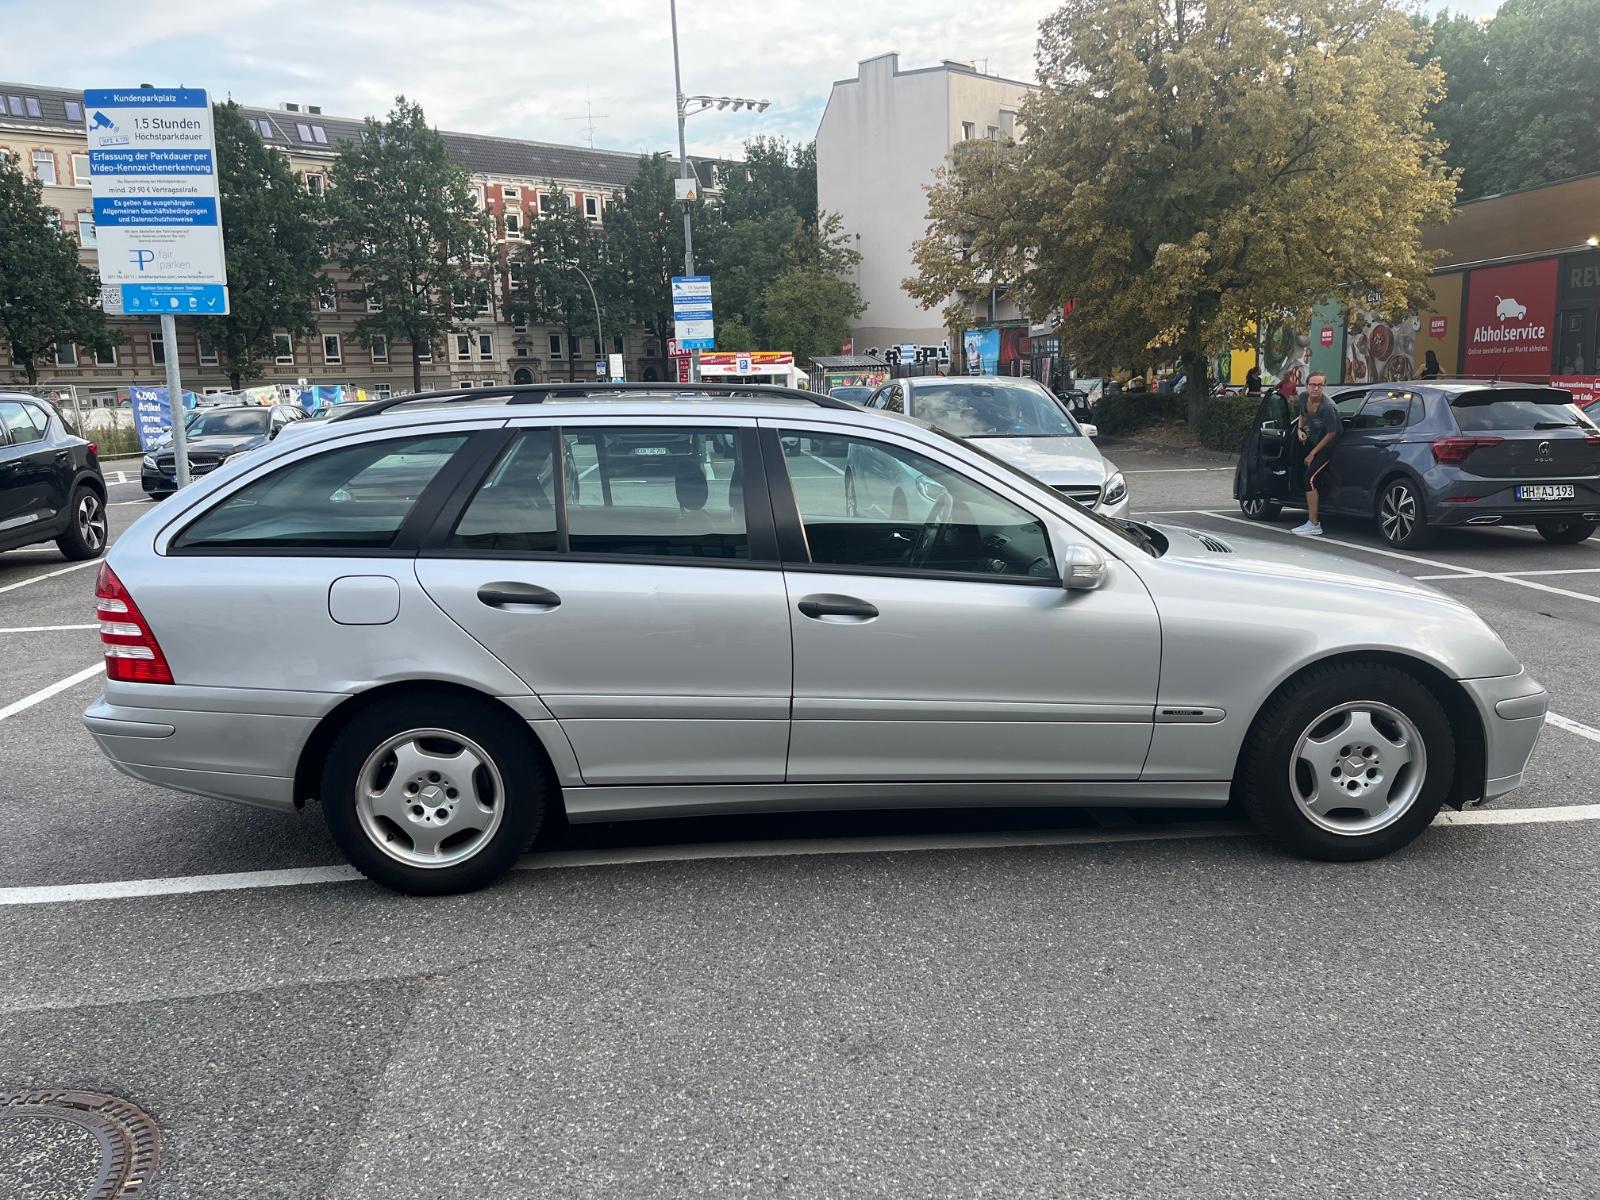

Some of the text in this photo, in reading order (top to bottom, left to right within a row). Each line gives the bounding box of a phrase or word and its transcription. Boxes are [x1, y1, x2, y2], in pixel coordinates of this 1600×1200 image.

[113, 94, 177, 103] Kundenparkplatz
[152, 117, 201, 129] Stunden
[134, 132, 203, 141] Höchstparkdauer
[93, 151, 208, 162] Erfassung der Parkdauer per
[91, 163, 211, 173] Video-Kennzeichenerkennung
[151, 186, 198, 194] Vertragsstrafe
[159, 260, 191, 271] parken
[1473, 322, 1546, 343] Abholservice
[138, 402, 161, 412] Artikel
[139, 413, 161, 423] immer
[1522, 485, 1573, 497] HH AJ 193
